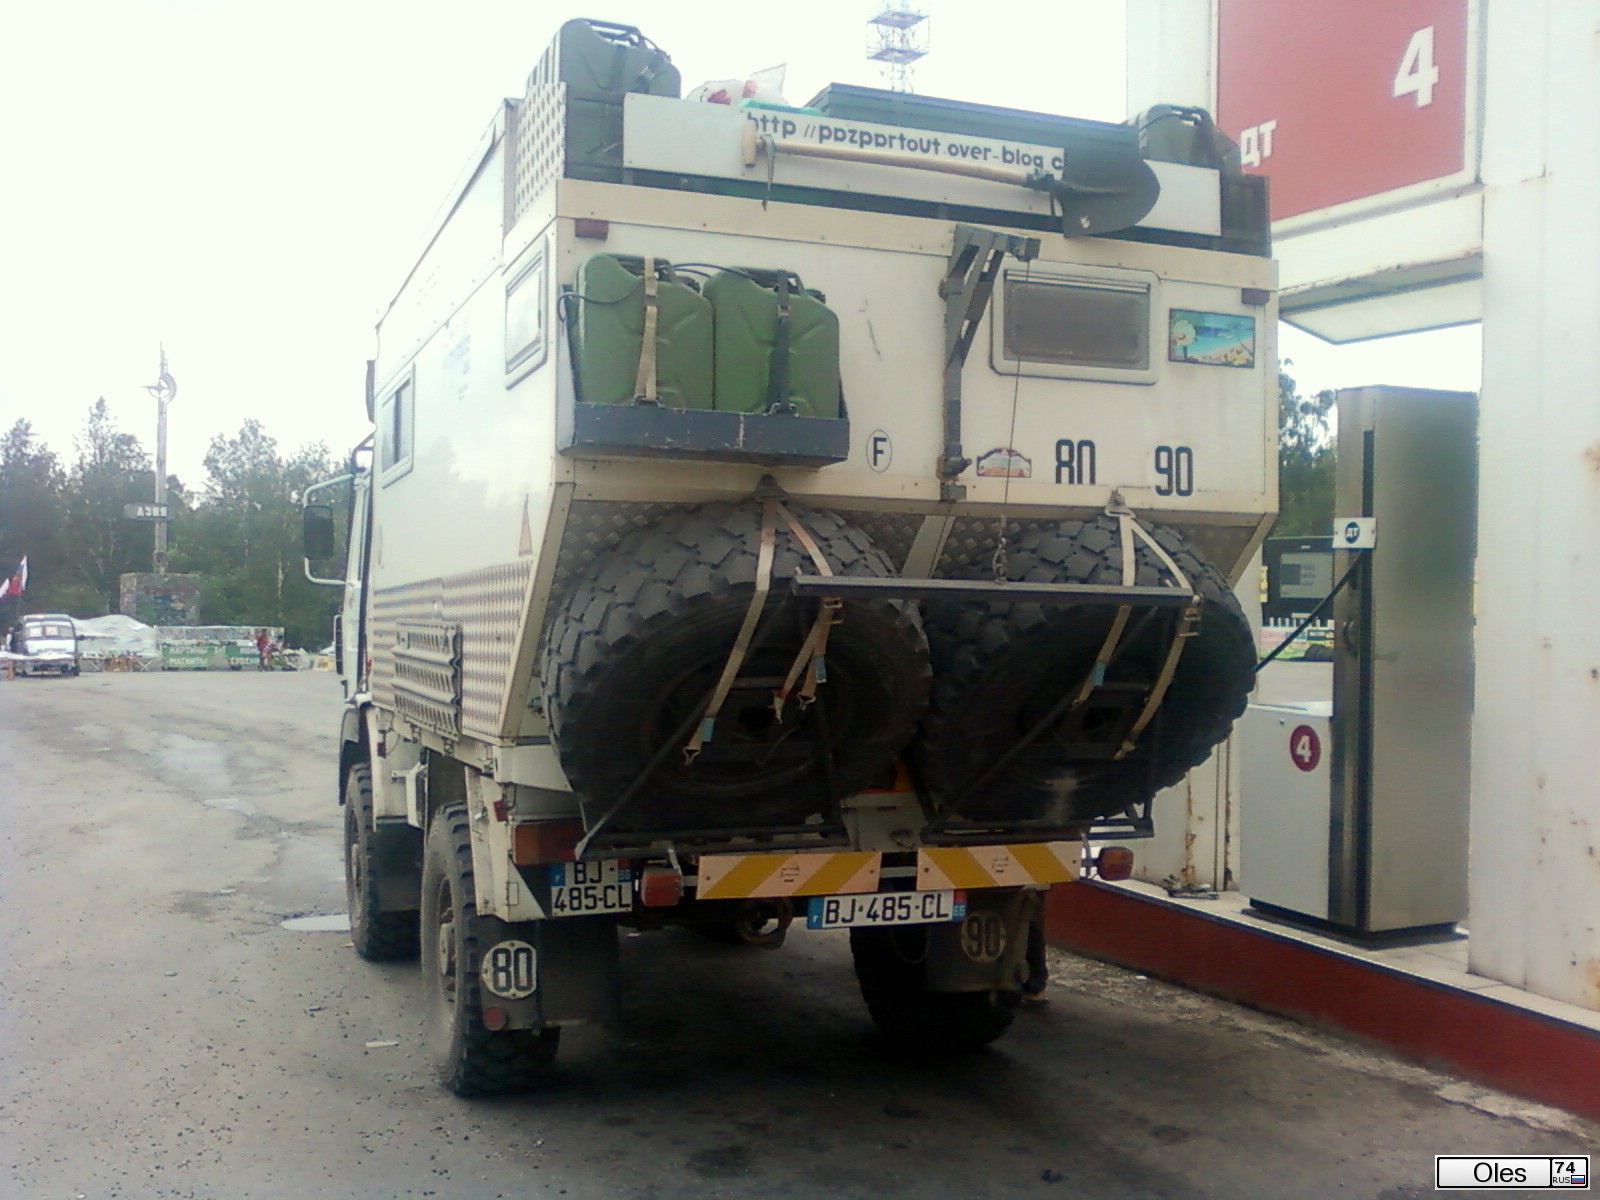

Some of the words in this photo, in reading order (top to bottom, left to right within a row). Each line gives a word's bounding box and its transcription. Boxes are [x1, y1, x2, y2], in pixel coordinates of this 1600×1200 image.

[1393, 25, 1440, 108] 4
[1240, 119, 1277, 168] ДТ
[873, 436, 888, 467] F
[1154, 445, 1194, 497] 90
[136, 506, 168, 517] АЗИЯ
[1296, 734, 1312, 763] 4
[554, 884, 632, 912] 485-CL
[966, 915, 1001, 958] 90
[491, 947, 534, 993] 80
